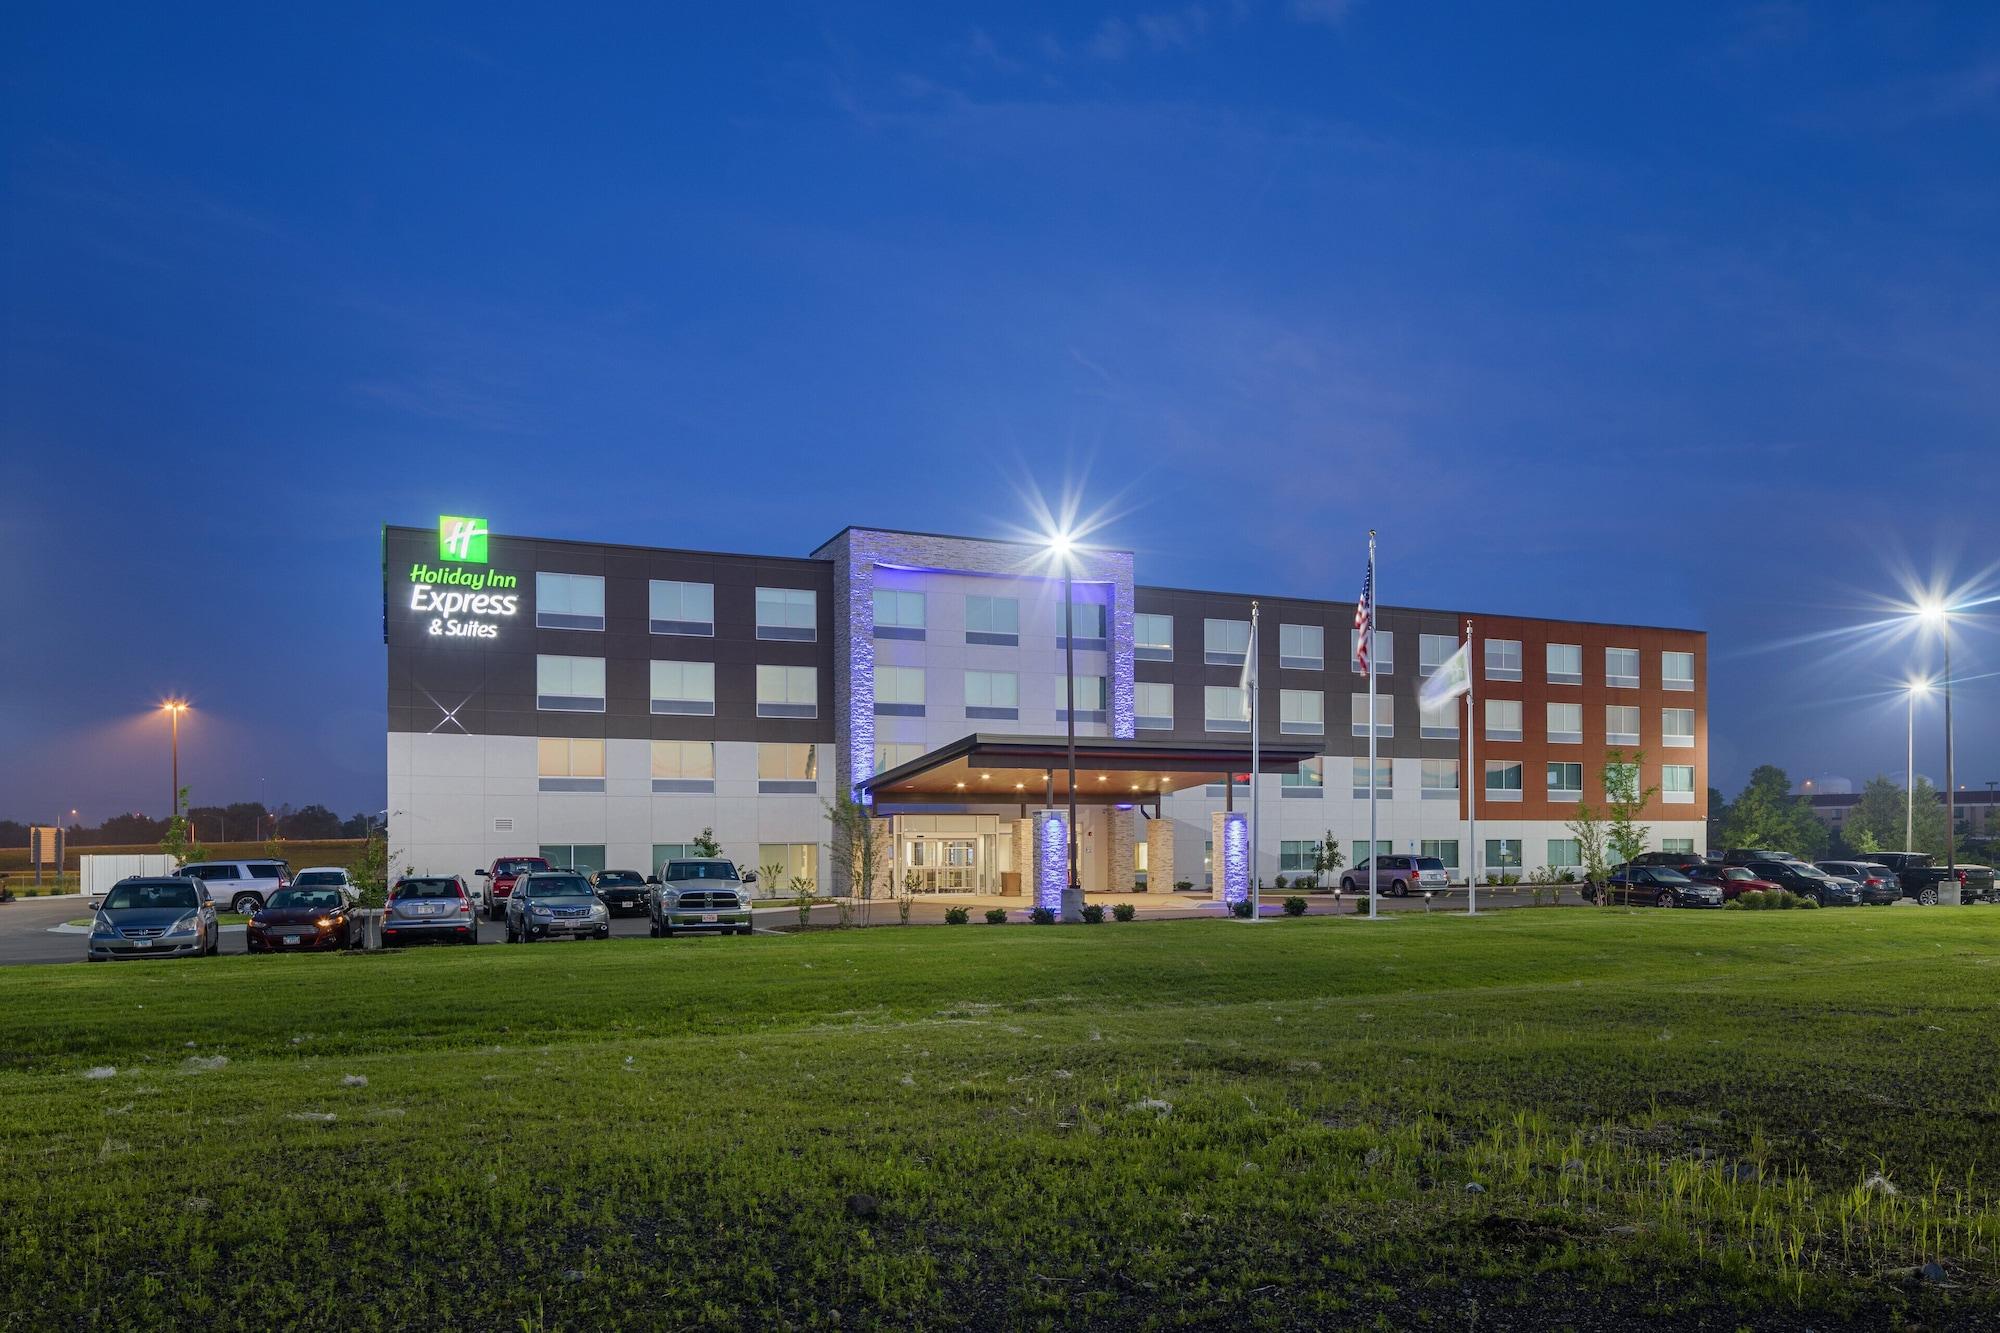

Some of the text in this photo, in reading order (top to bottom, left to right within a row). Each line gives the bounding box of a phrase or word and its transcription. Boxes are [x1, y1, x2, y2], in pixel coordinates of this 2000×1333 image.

[410, 564, 517, 590] Holiday Inn
[410, 584, 518, 619] Express
[428, 618, 498, 638] & Suites
